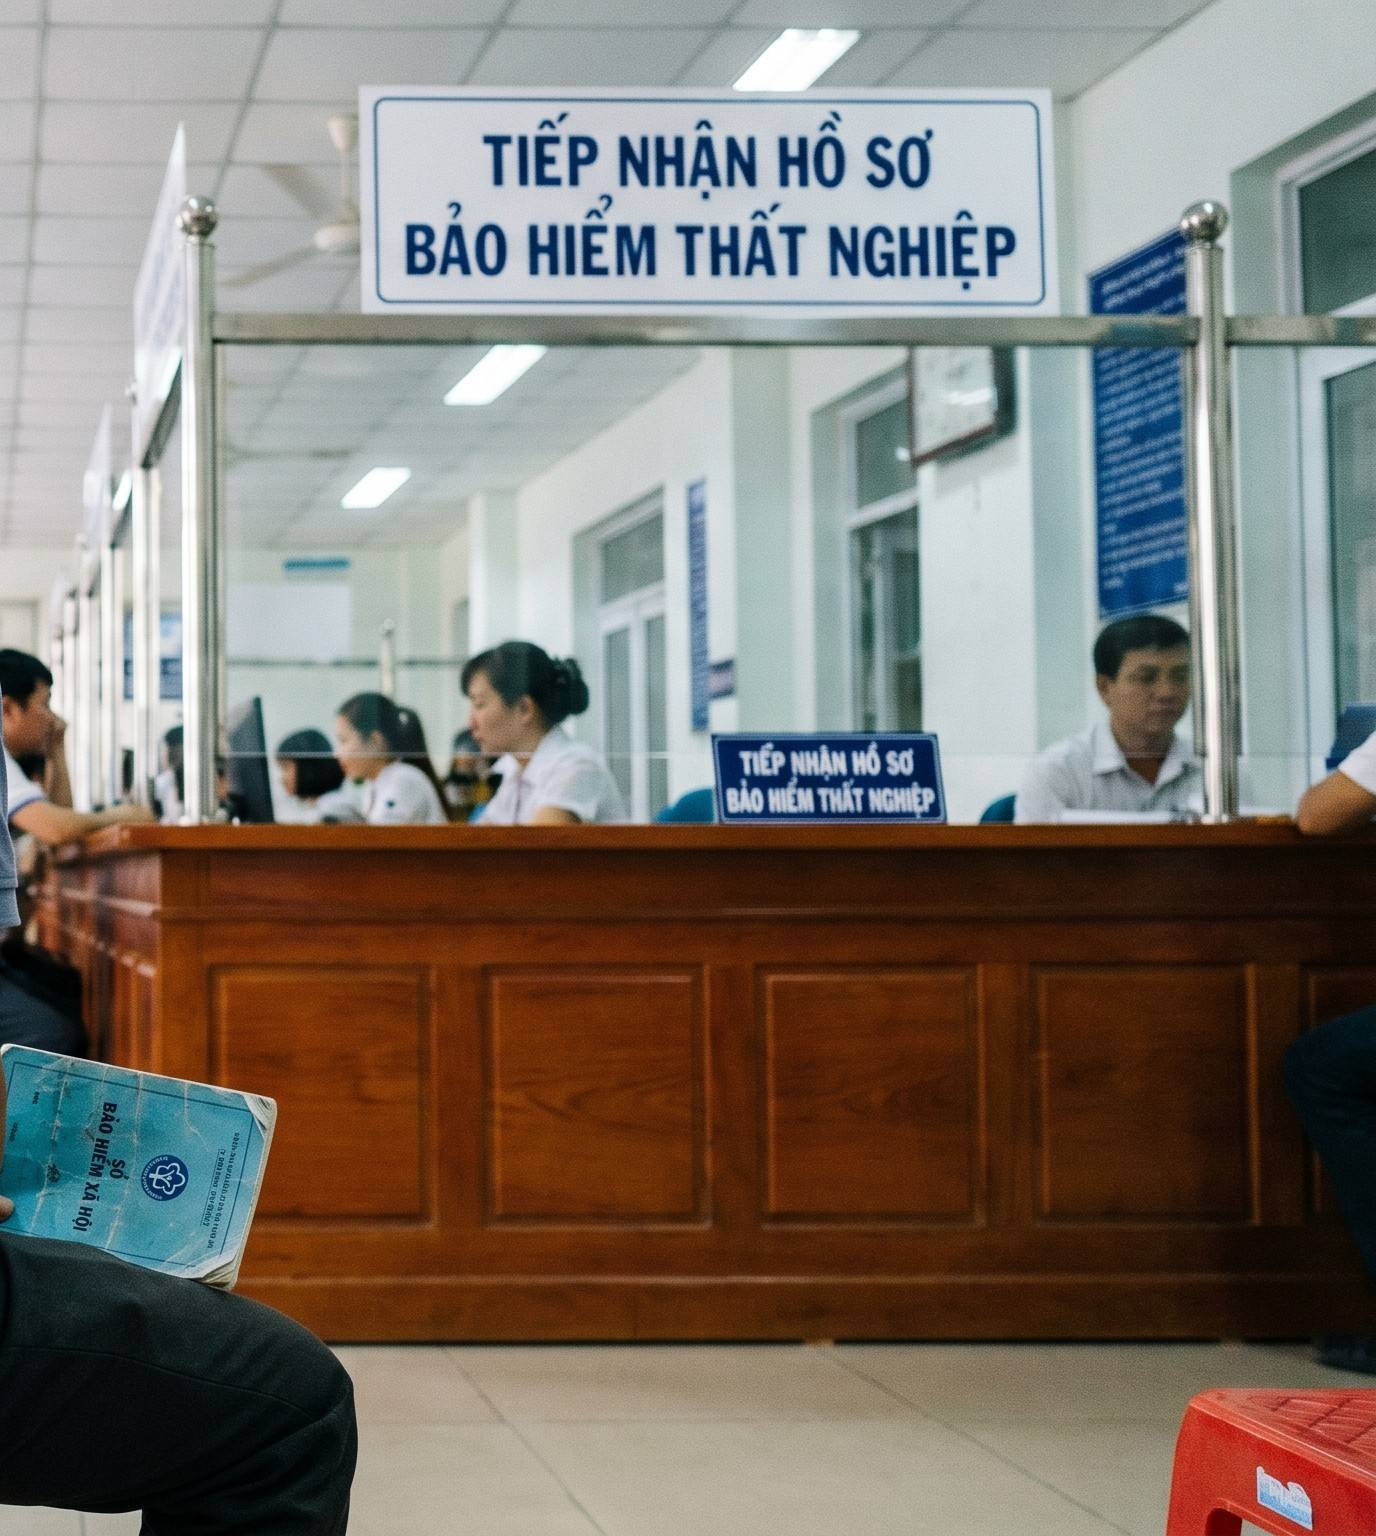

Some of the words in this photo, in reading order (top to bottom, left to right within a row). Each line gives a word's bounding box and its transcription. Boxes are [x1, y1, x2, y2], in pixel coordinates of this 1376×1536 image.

[482, 111, 599, 188] TIẾP
[618, 119, 758, 201] NHẬN
[777, 111, 847, 189] HỒ
[865, 128, 934, 190] SƠ
[405, 201, 508, 277] BẢO
[527, 193, 657, 277] HIỂM
[674, 202, 808, 278] THẤT
[828, 209, 1017, 291] NGHIỆP
[739, 742, 786, 776] TIẾP
[790, 744, 848, 782] NHẬN
[885, 748, 914, 776] SƠ
[725, 778, 764, 814] BẢO
[816, 778, 864, 814] THẤT
[868, 781, 936, 820] NGHIỆP
[71, 1206, 94, 1232] HỘI
